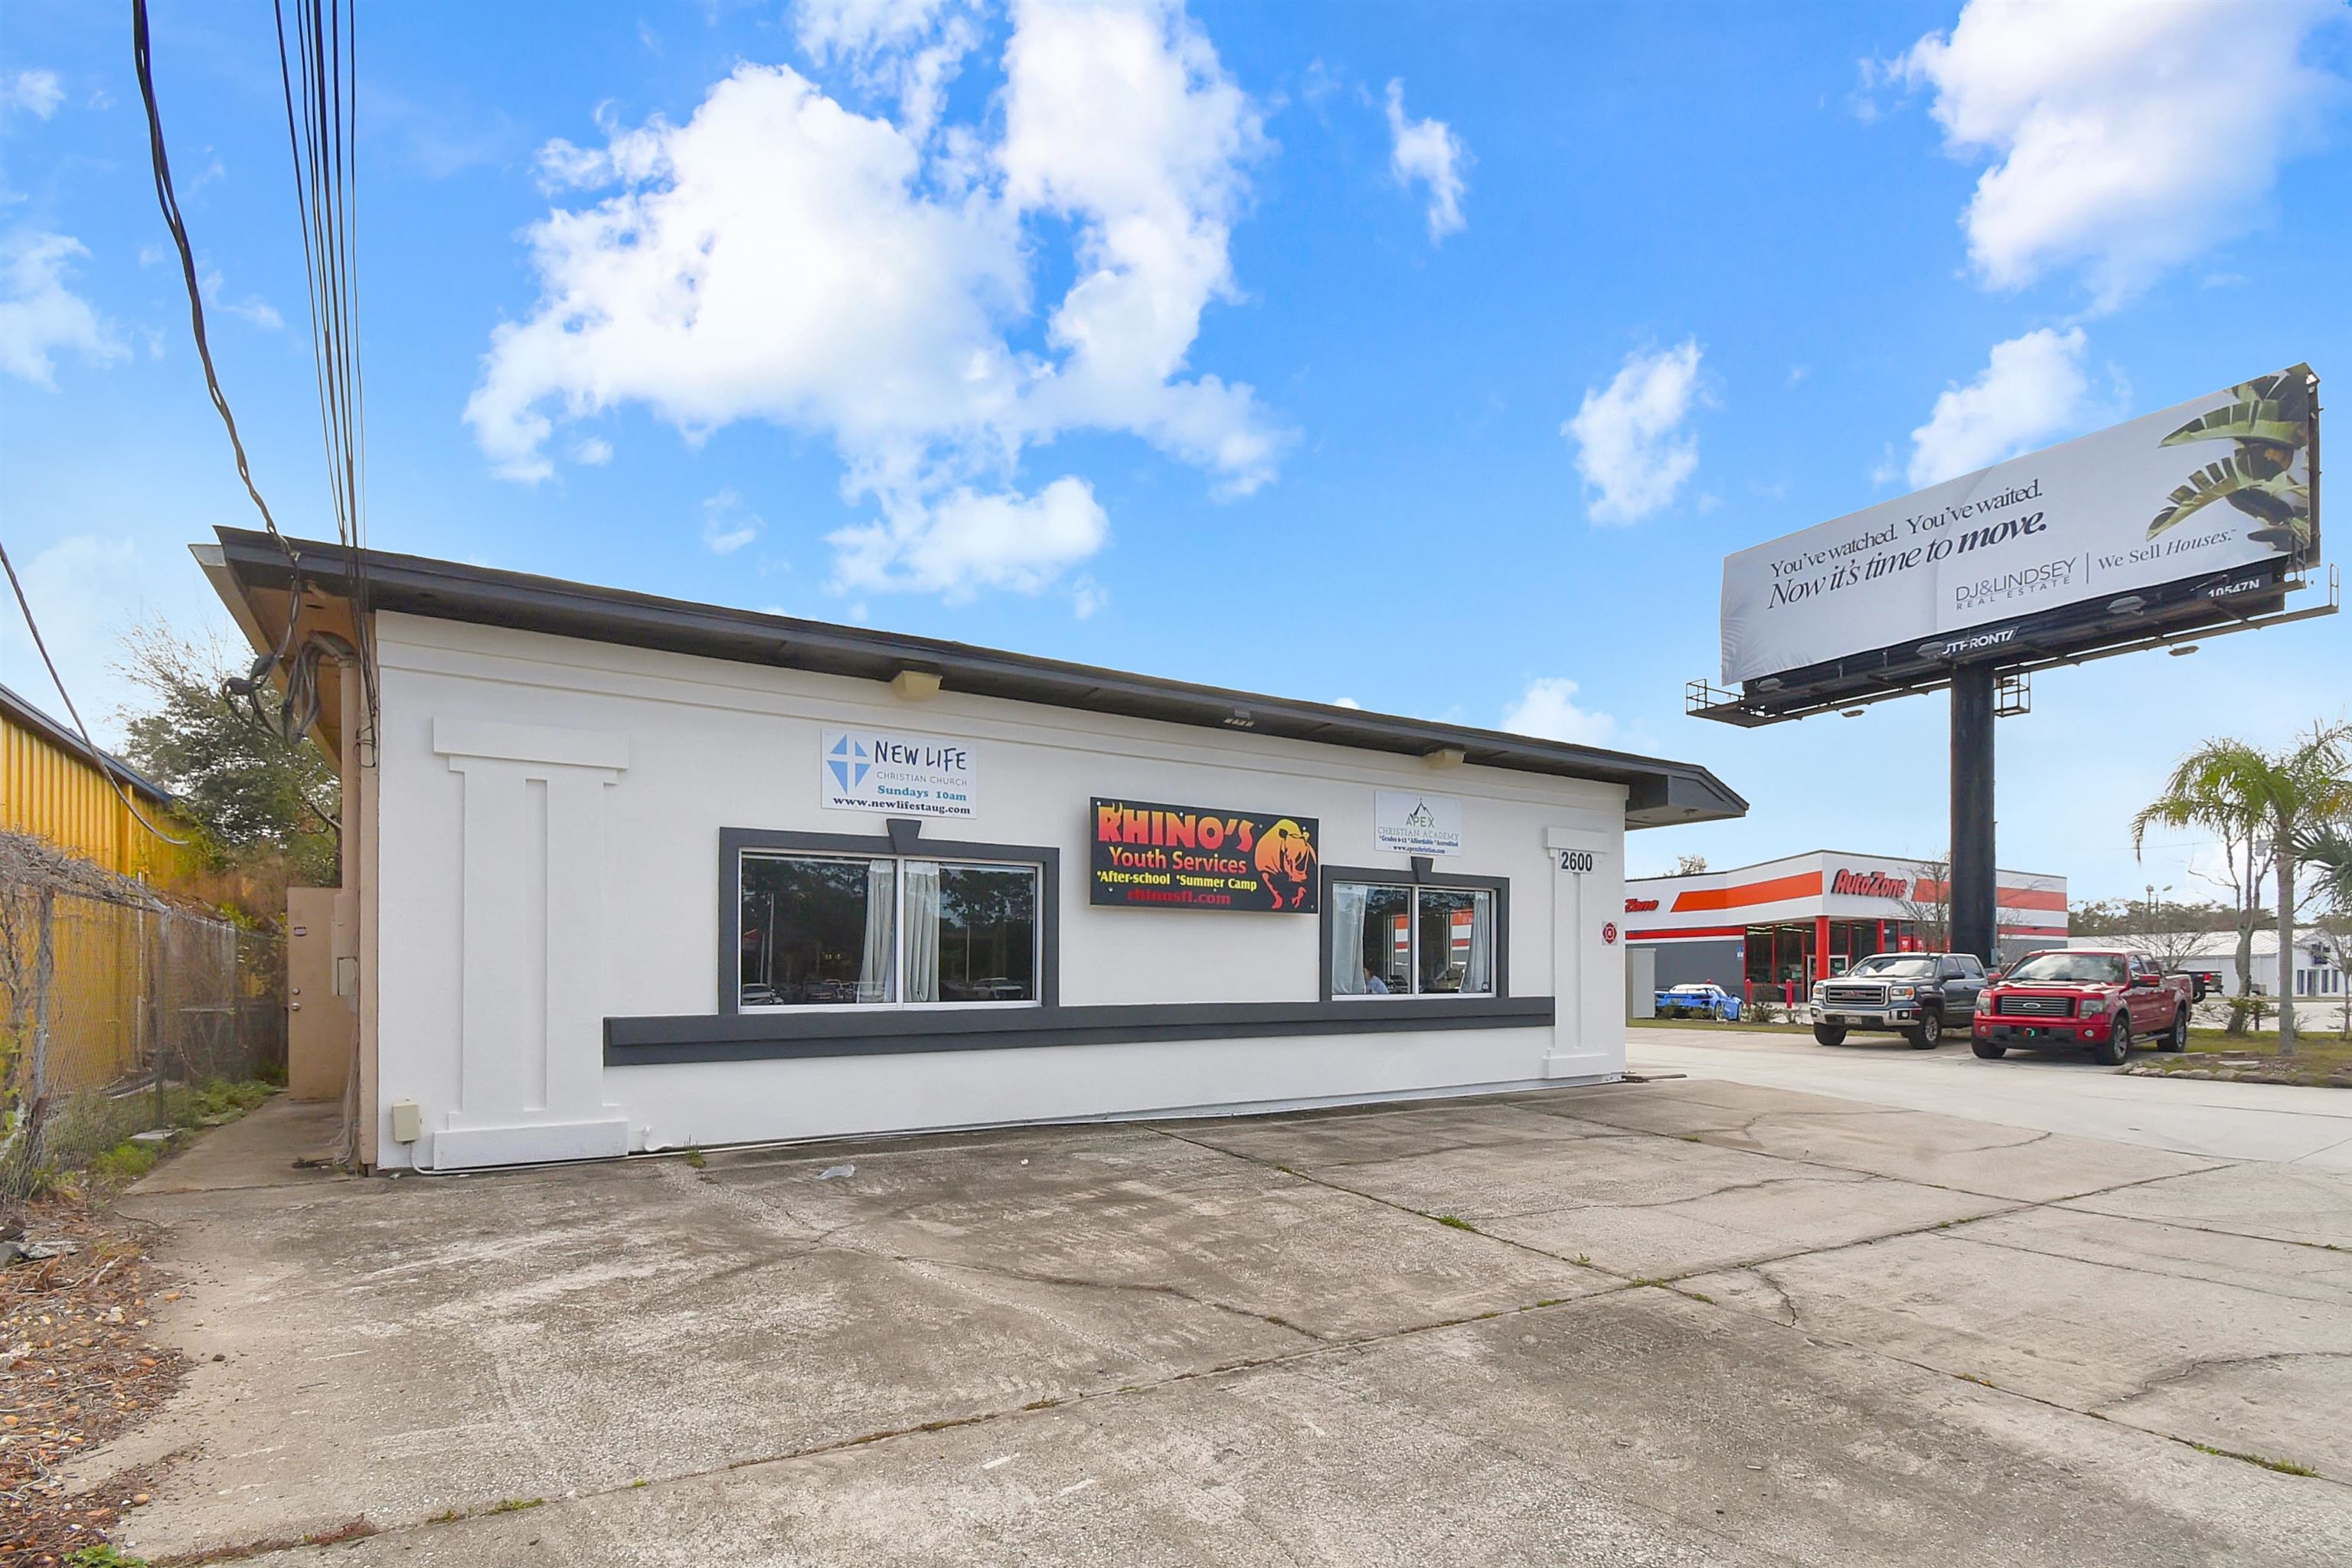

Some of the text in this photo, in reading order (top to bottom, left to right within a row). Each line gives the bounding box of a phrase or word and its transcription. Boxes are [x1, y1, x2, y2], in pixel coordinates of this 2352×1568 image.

[1770, 479, 2043, 577] You've watched. You've waited.
[1767, 511, 2047, 609] Now it's time to move.
[2098, 554, 2123, 570] We
[2129, 544, 2160, 564] Sell
[1956, 557, 2077, 602] DJ&LINDSEY
[2207, 578, 2260, 597] 10547N
[1956, 577, 2070, 610] REAL ESTATE
[875, 740, 966, 773] NEW LIFE
[877, 771, 967, 787] CHRISTIAN CHURCH
[877, 785, 967, 802] Sundays 10am
[833, 798, 971, 815] www.newlifestaug.com
[1098, 802, 1255, 852] RHINO'S
[1378, 826, 1459, 840] CHRISTIAN ACADEMY
[1406, 815, 1435, 828] APEX
[1109, 846, 1247, 874] Youth Services
[1561, 851, 1592, 872] 2600
[1228, 878, 1257, 892] Camp
[1831, 868, 1907, 898] AutoZone
[1625, 898, 1659, 913] Zone
